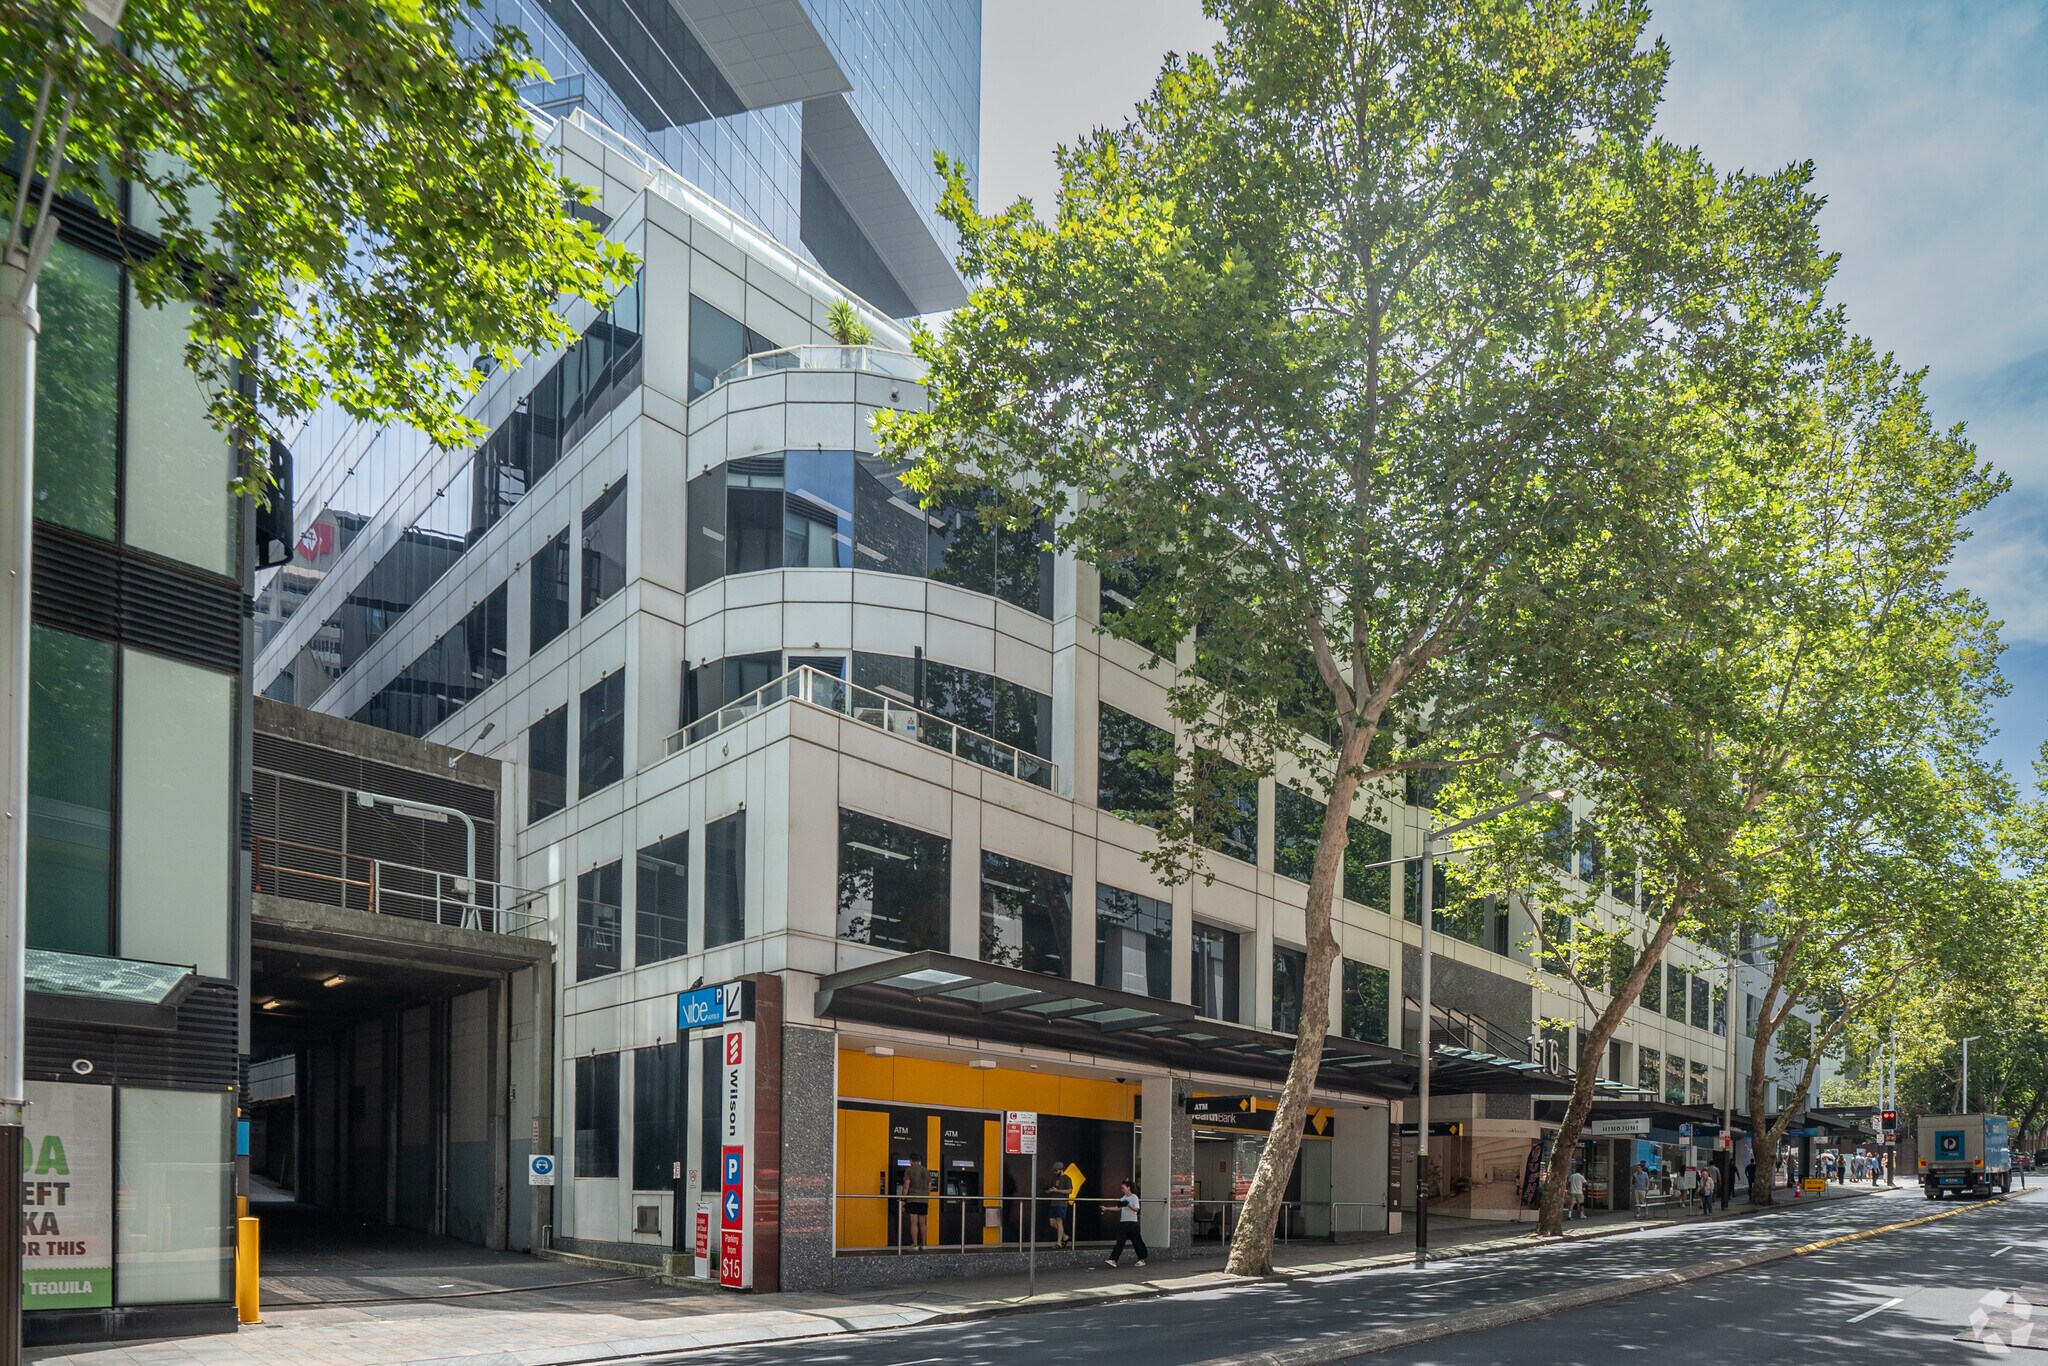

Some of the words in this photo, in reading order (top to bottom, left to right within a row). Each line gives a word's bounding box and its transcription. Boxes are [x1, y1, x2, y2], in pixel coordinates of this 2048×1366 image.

[716, 988, 723, 1003] P
[1526, 1034, 1559, 1074] 116
[894, 1126, 909, 1134] ATM
[728, 1158, 738, 1180] P
[724, 1233, 739, 1245] Parking
[46, 1241, 86, 1256] THIS
[722, 1257, 740, 1279] $15
[30, 1281, 93, 1295] TEQUILA
